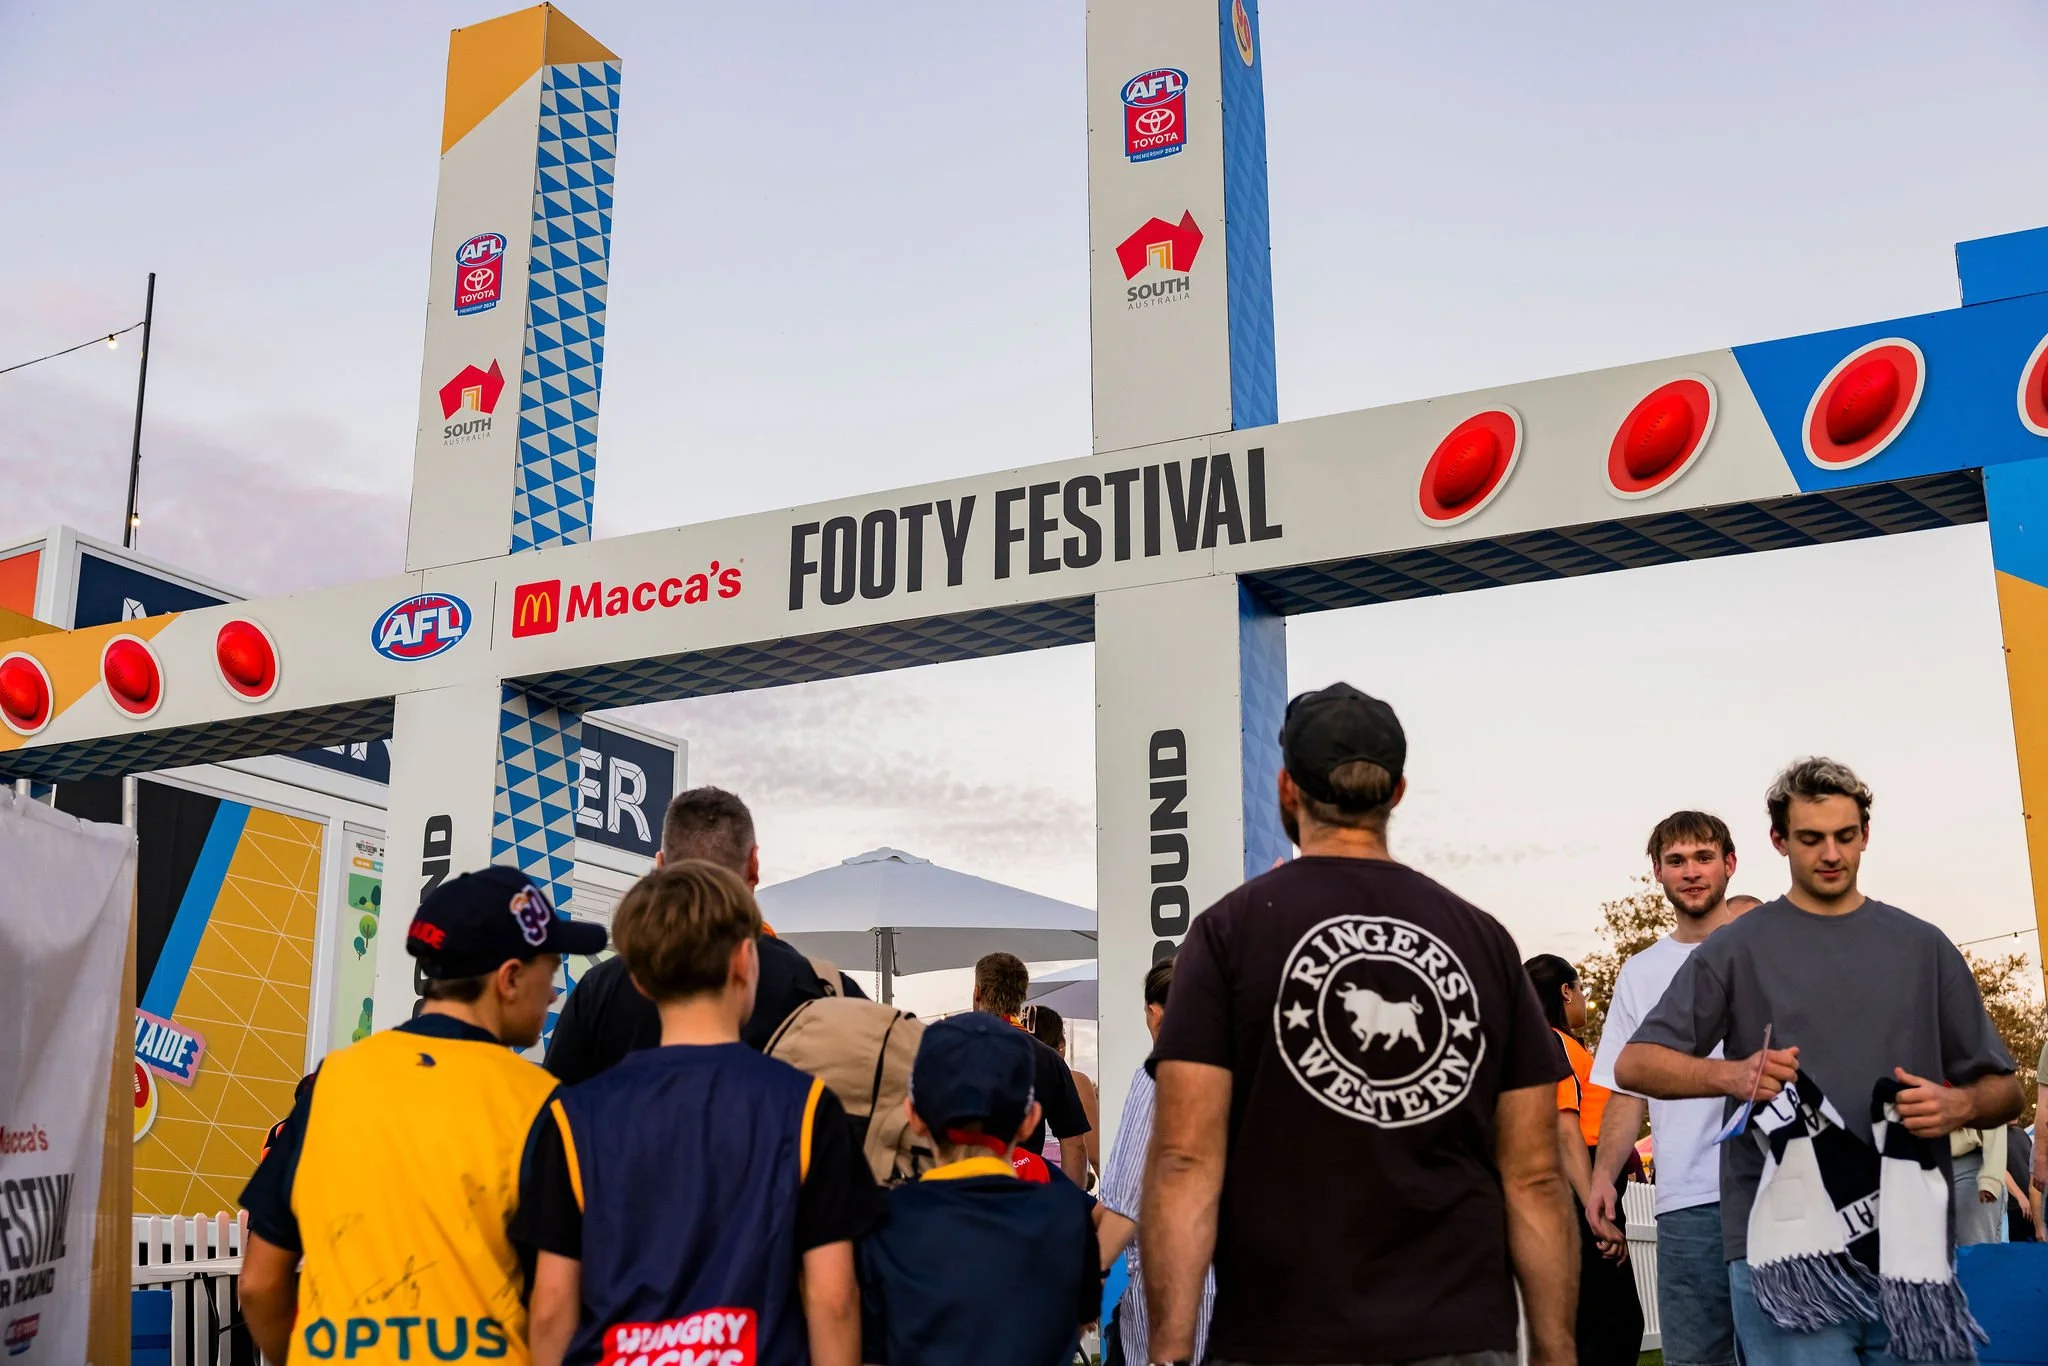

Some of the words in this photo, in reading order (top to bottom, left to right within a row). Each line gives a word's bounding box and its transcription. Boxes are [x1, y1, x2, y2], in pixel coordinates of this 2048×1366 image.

[1126, 74, 1184, 102] AFL
[1132, 131, 1179, 149] TOYOTA
[1164, 146, 1180, 154] 2024
[459, 238, 503, 262] AFL
[460, 289, 495, 304] TOYOTA
[1127, 276, 1190, 302] SOUTH
[1128, 293, 1190, 311] AUSTRALIA
[443, 417, 492, 439] SOUTH
[443, 432, 491, 447] AUSTRALIA
[379, 605, 462, 649] AFL
[565, 560, 742, 623] Macca's
[788, 495, 977, 611] FOOTY
[994, 447, 1283, 580] FESTIVAL
[577, 746, 652, 843] ER
[1290, 922, 1469, 1001] RINGERS
[1298, 1037, 1471, 1122] WESTERN
[304, 1316, 508, 1361] OPTUS
[616, 1312, 748, 1354] HUNGRY
